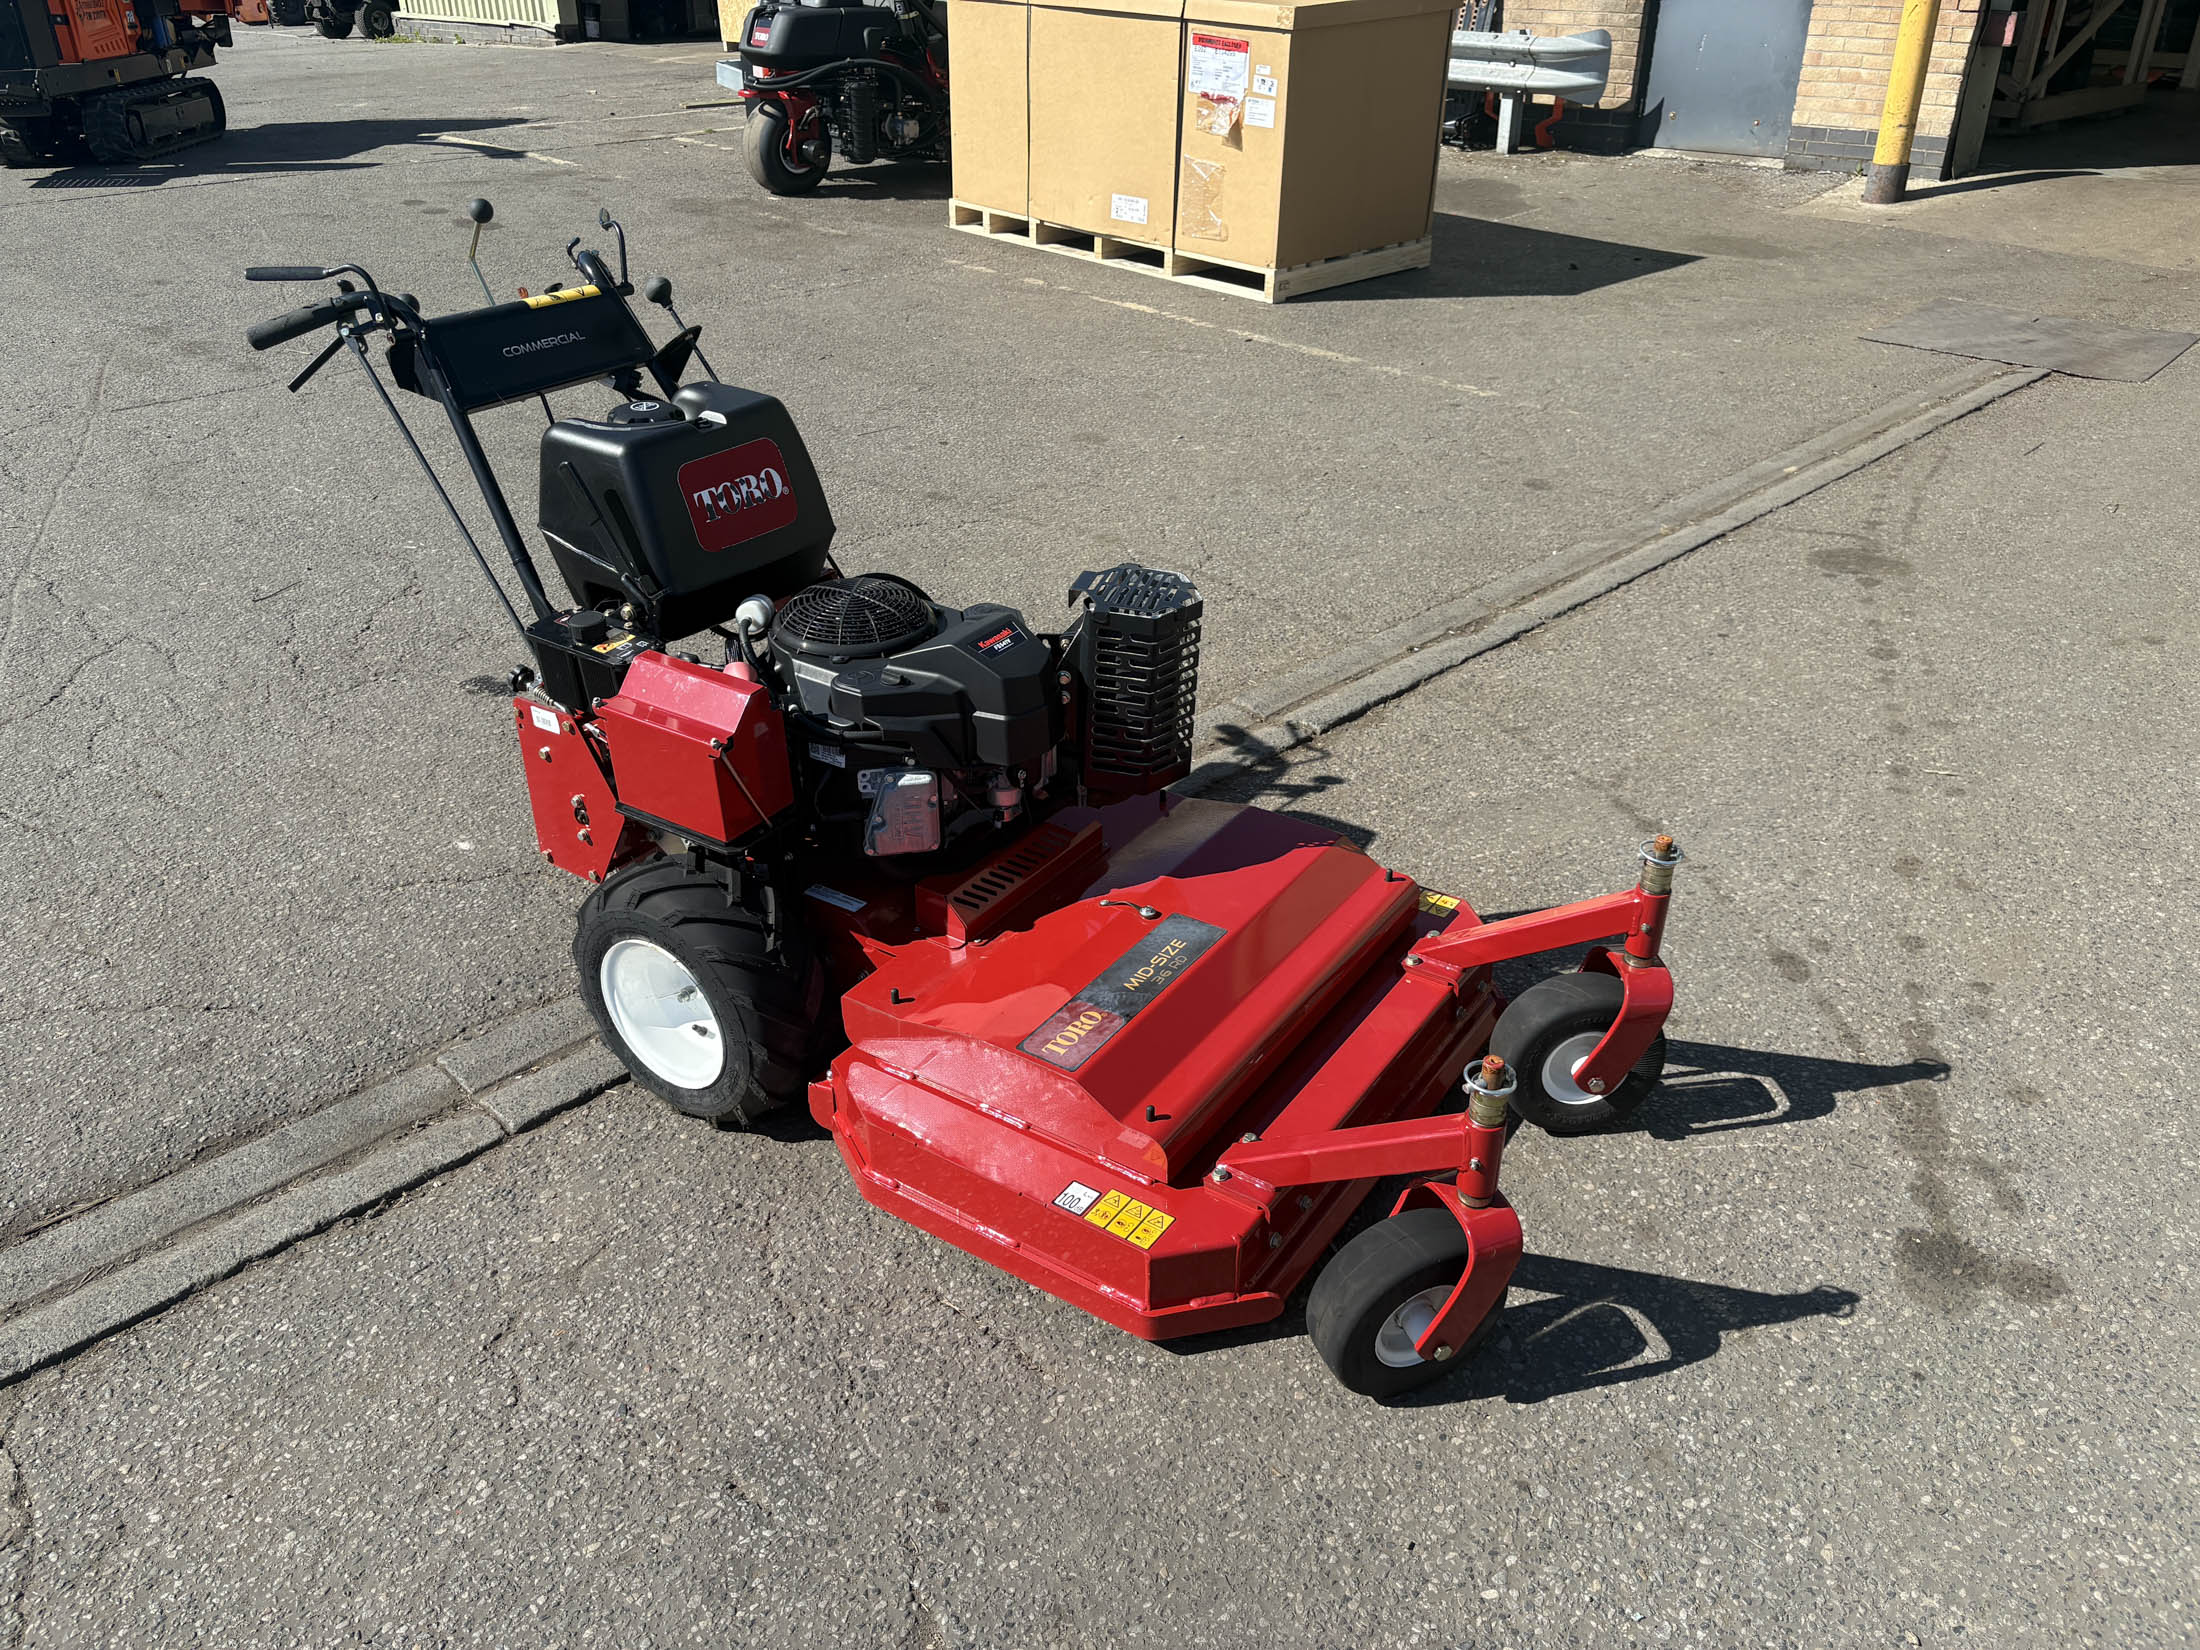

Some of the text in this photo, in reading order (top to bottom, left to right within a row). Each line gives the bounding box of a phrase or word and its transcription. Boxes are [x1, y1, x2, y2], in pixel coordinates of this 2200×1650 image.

[502, 331, 586, 357] COMMERCIAL
[977, 627, 1012, 648] Kawasaki
[1123, 938, 1187, 991] MID-SIZE
[1151, 955, 1188, 985] 36 RD
[1042, 1010, 1102, 1056] TORO
[1058, 1192, 1081, 1209] 100
